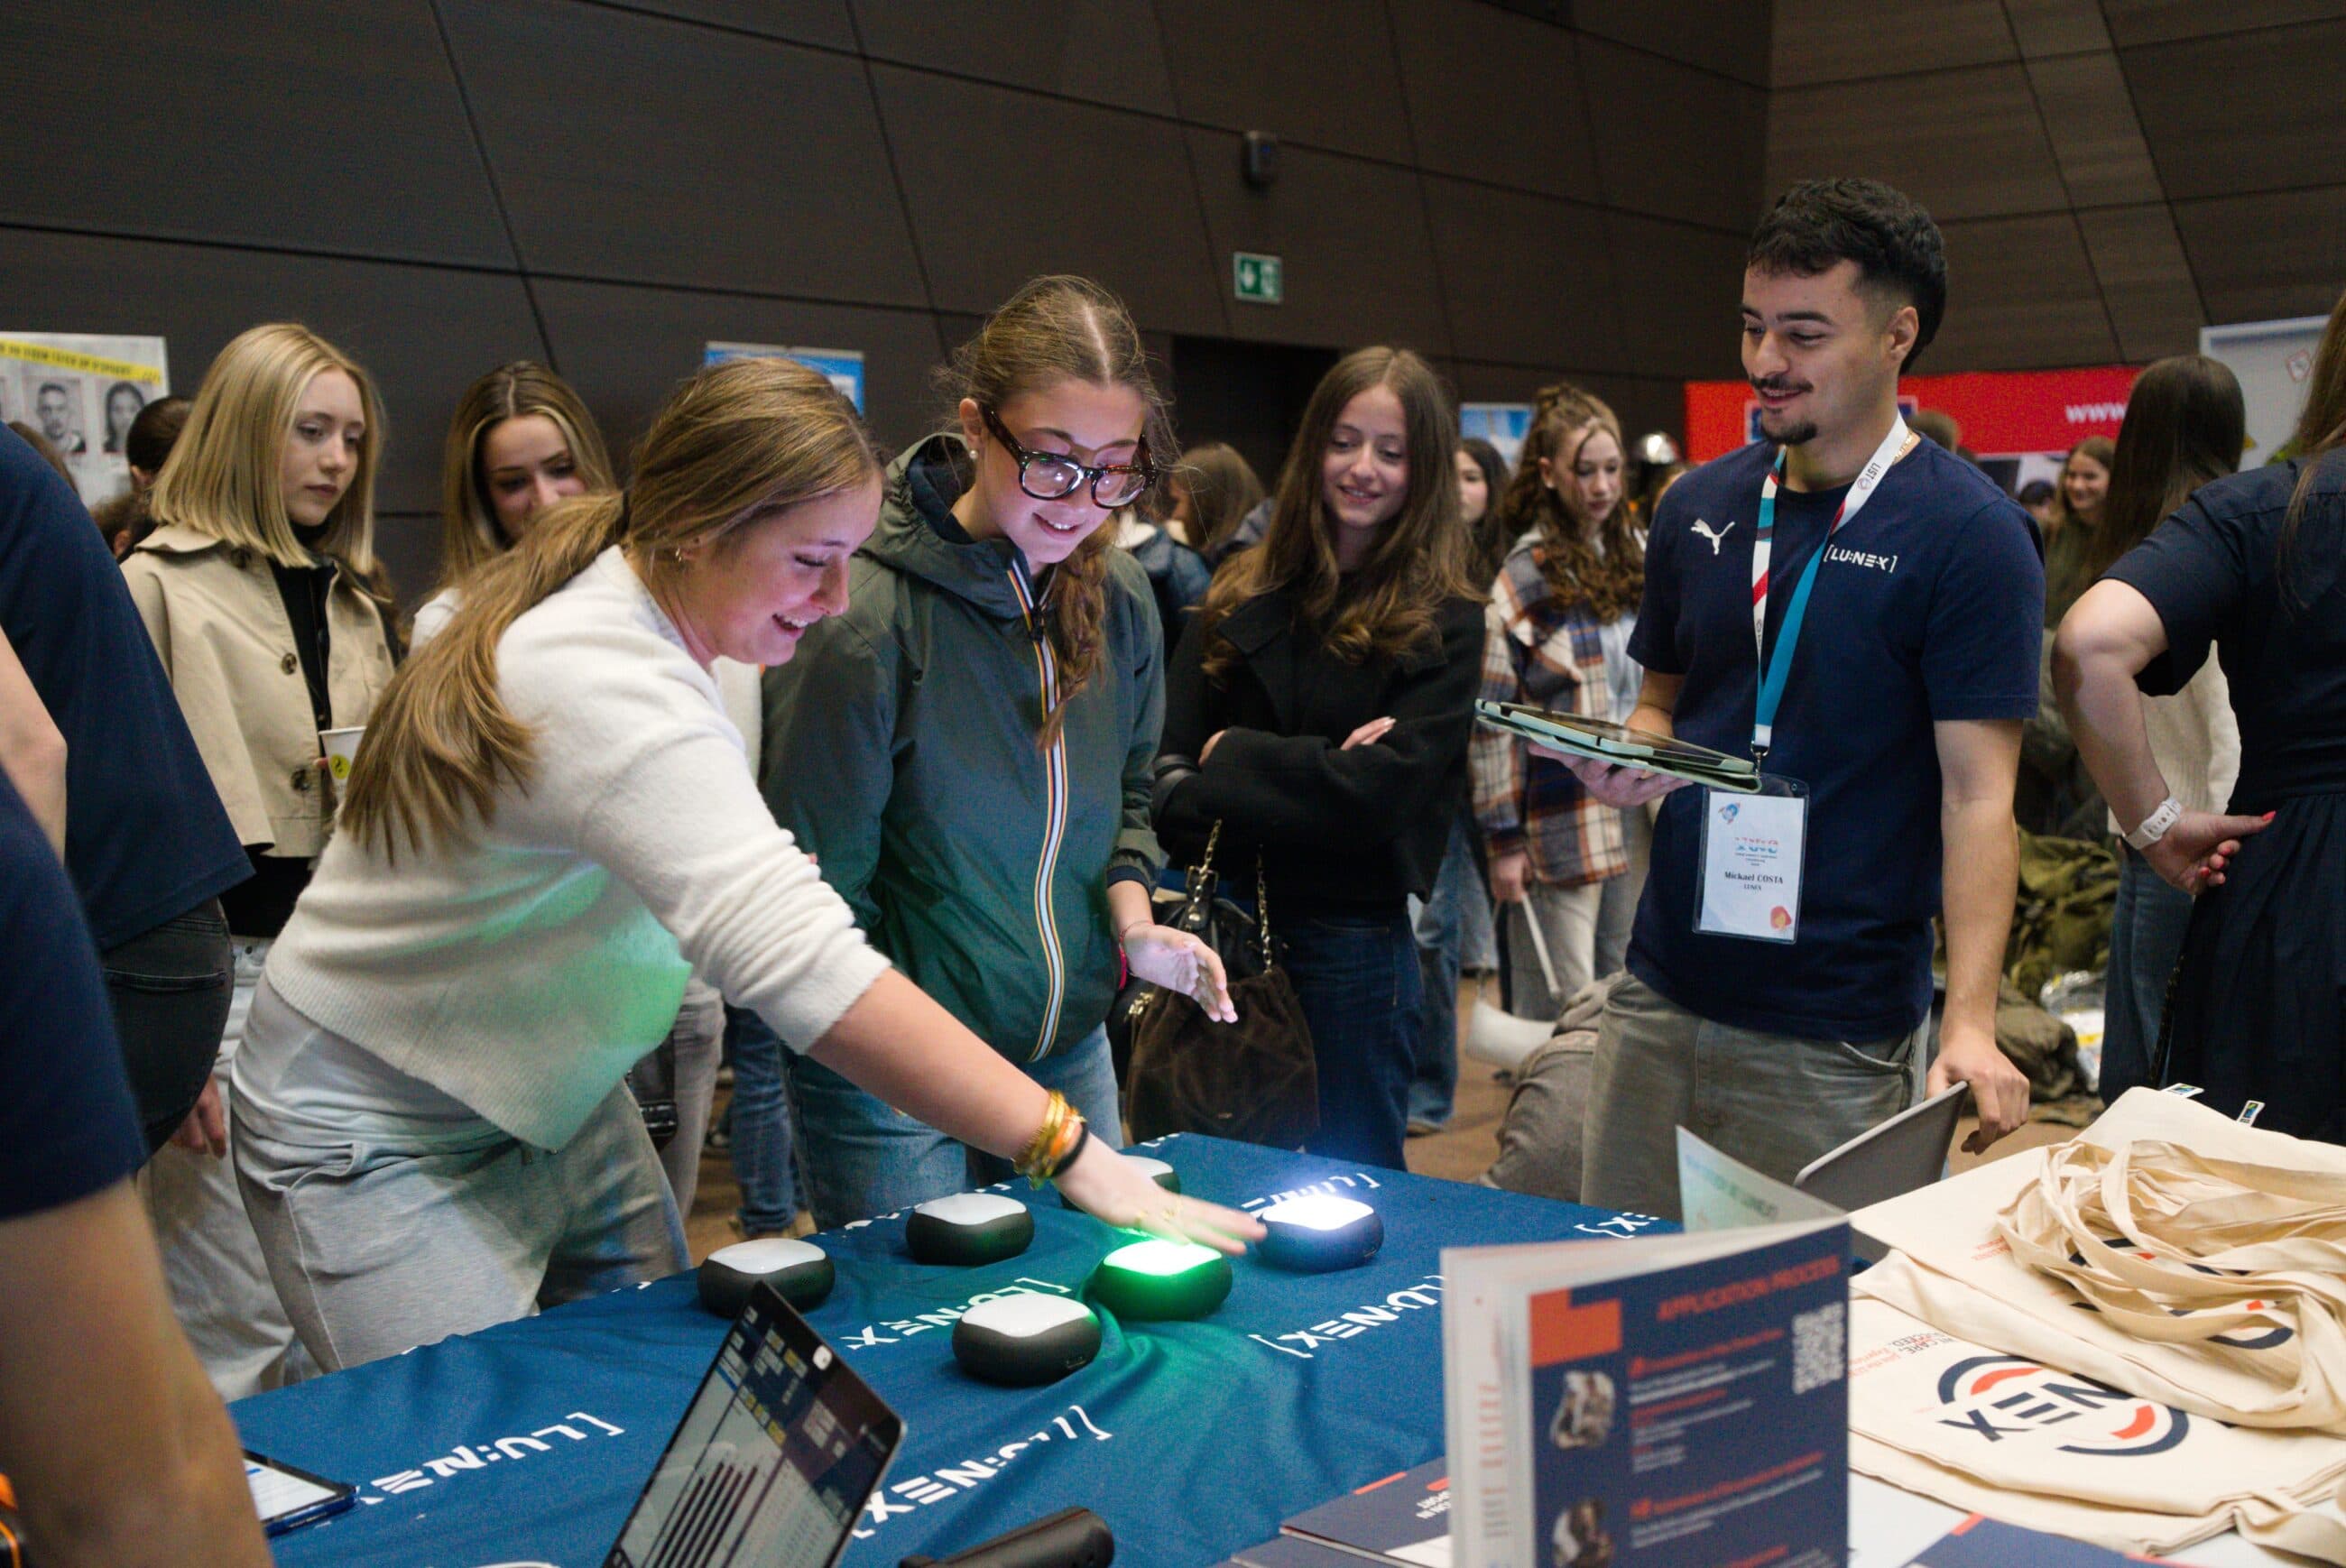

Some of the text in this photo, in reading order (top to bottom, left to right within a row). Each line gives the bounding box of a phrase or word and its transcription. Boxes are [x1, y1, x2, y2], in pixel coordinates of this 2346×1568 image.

[1865, 462, 1881, 480] LIST
[1757, 874, 1784, 884] COSTA
[1934, 1372, 2136, 1443] NEX
